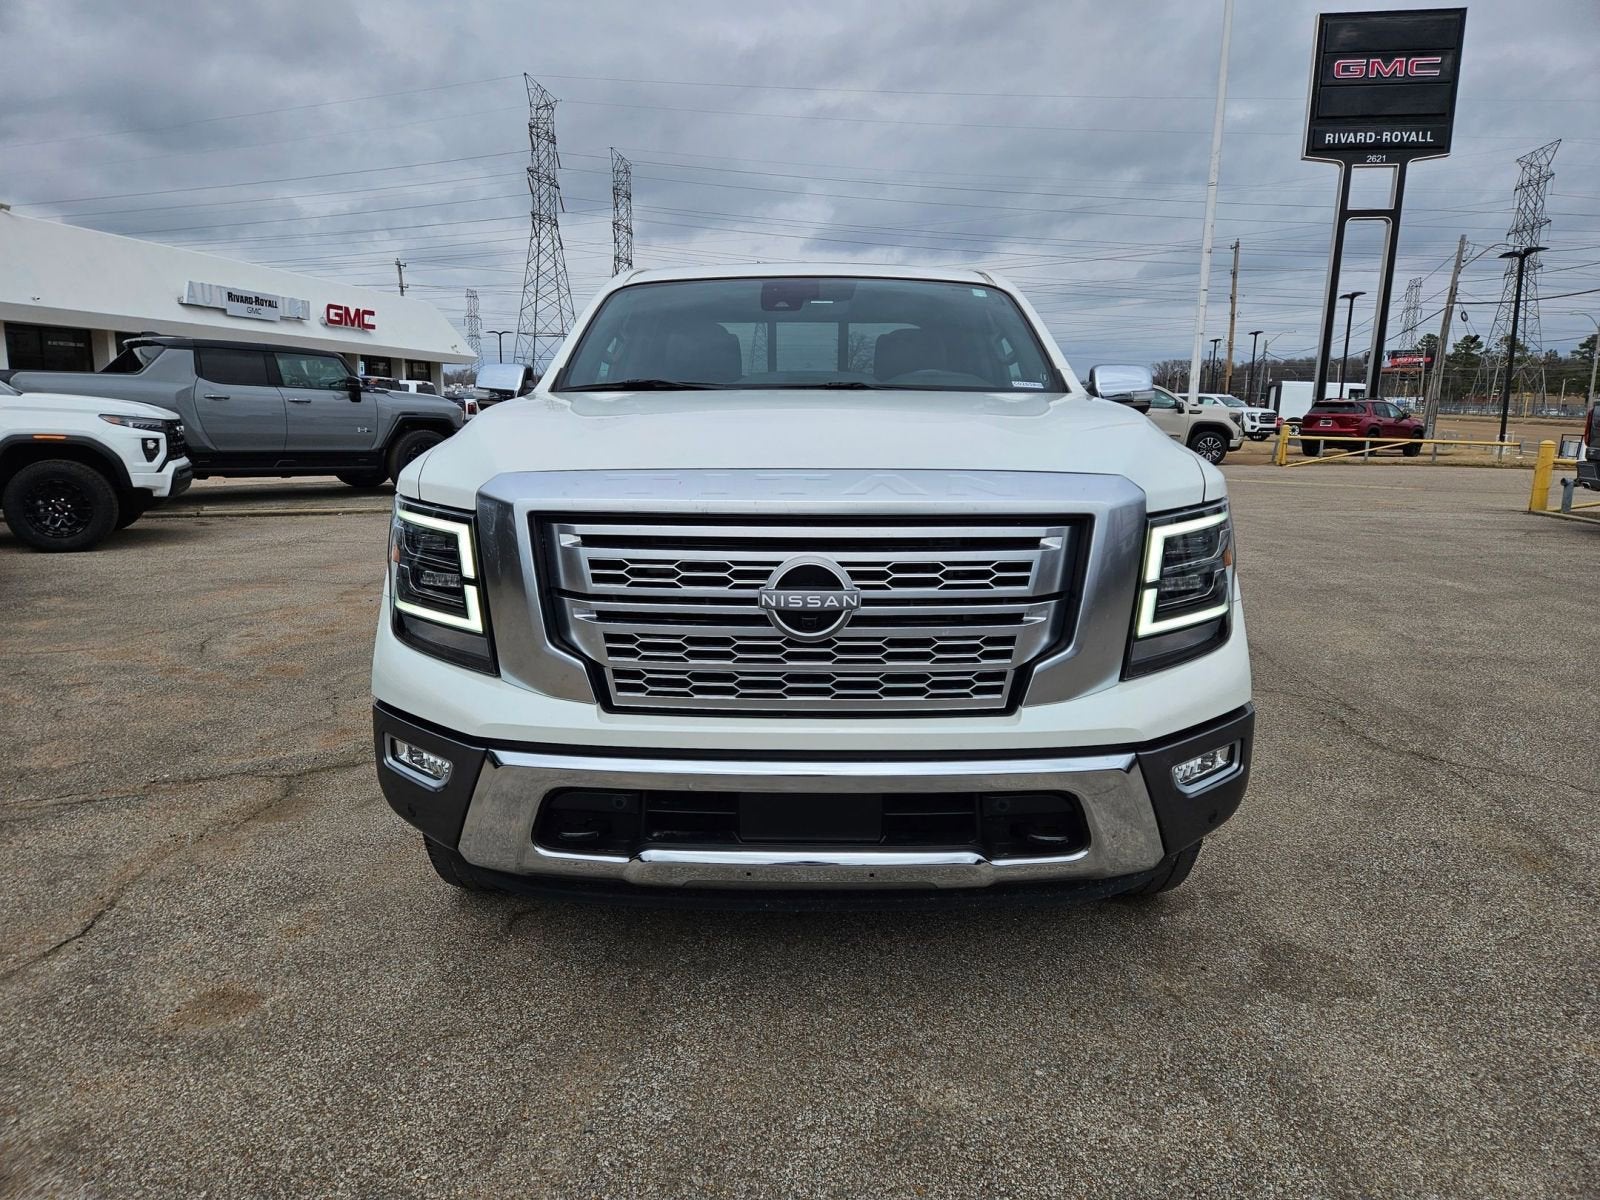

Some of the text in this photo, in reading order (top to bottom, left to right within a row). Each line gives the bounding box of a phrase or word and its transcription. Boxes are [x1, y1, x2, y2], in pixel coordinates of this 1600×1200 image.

[1334, 57, 1441, 78] GMC
[1325, 131, 1434, 144] RIVARD-ROYALL
[1366, 154, 1386, 163] 2621
[247, 306, 262, 316] GMC
[326, 303, 376, 330] GMC
[761, 593, 858, 608] NISSAN
